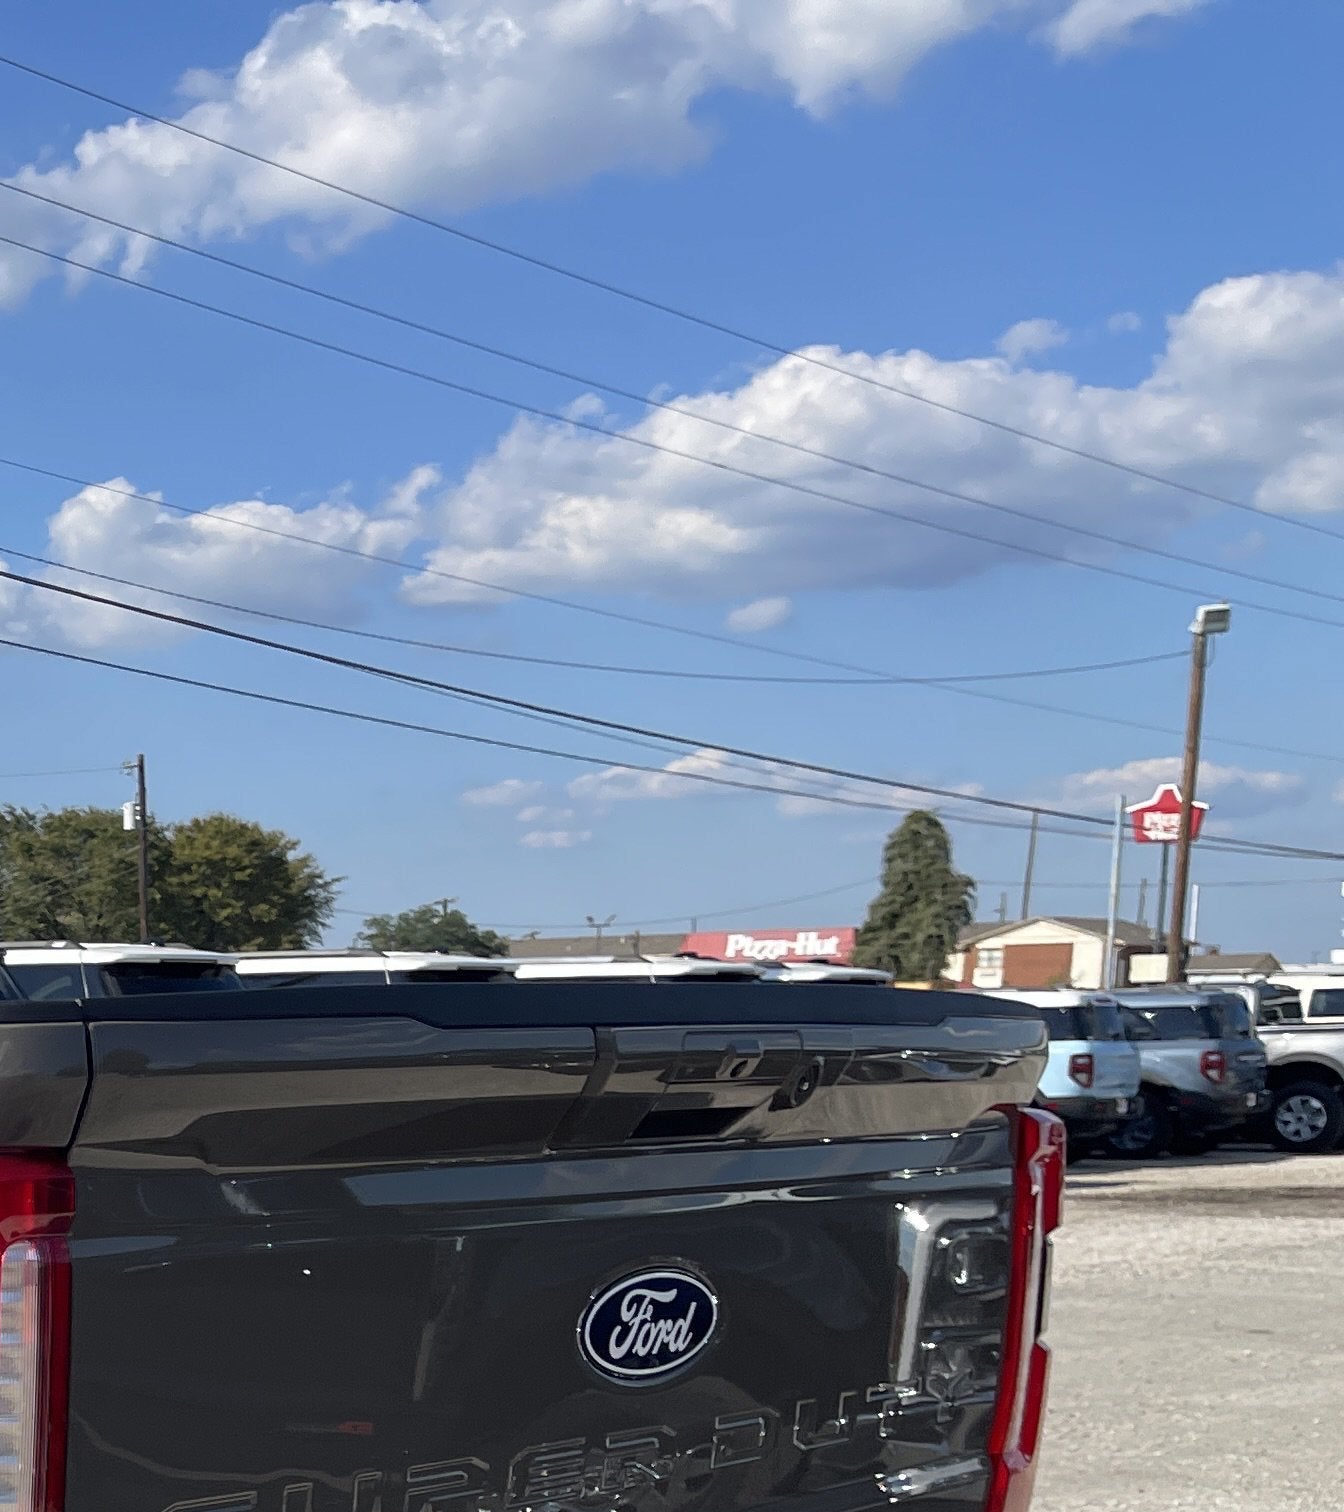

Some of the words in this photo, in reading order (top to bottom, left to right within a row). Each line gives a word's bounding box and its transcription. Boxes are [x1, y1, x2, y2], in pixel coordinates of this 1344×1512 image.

[725, 933, 788, 960] Pizza
[794, 931, 842, 957] Hut
[608, 1288, 698, 1360] Ford
